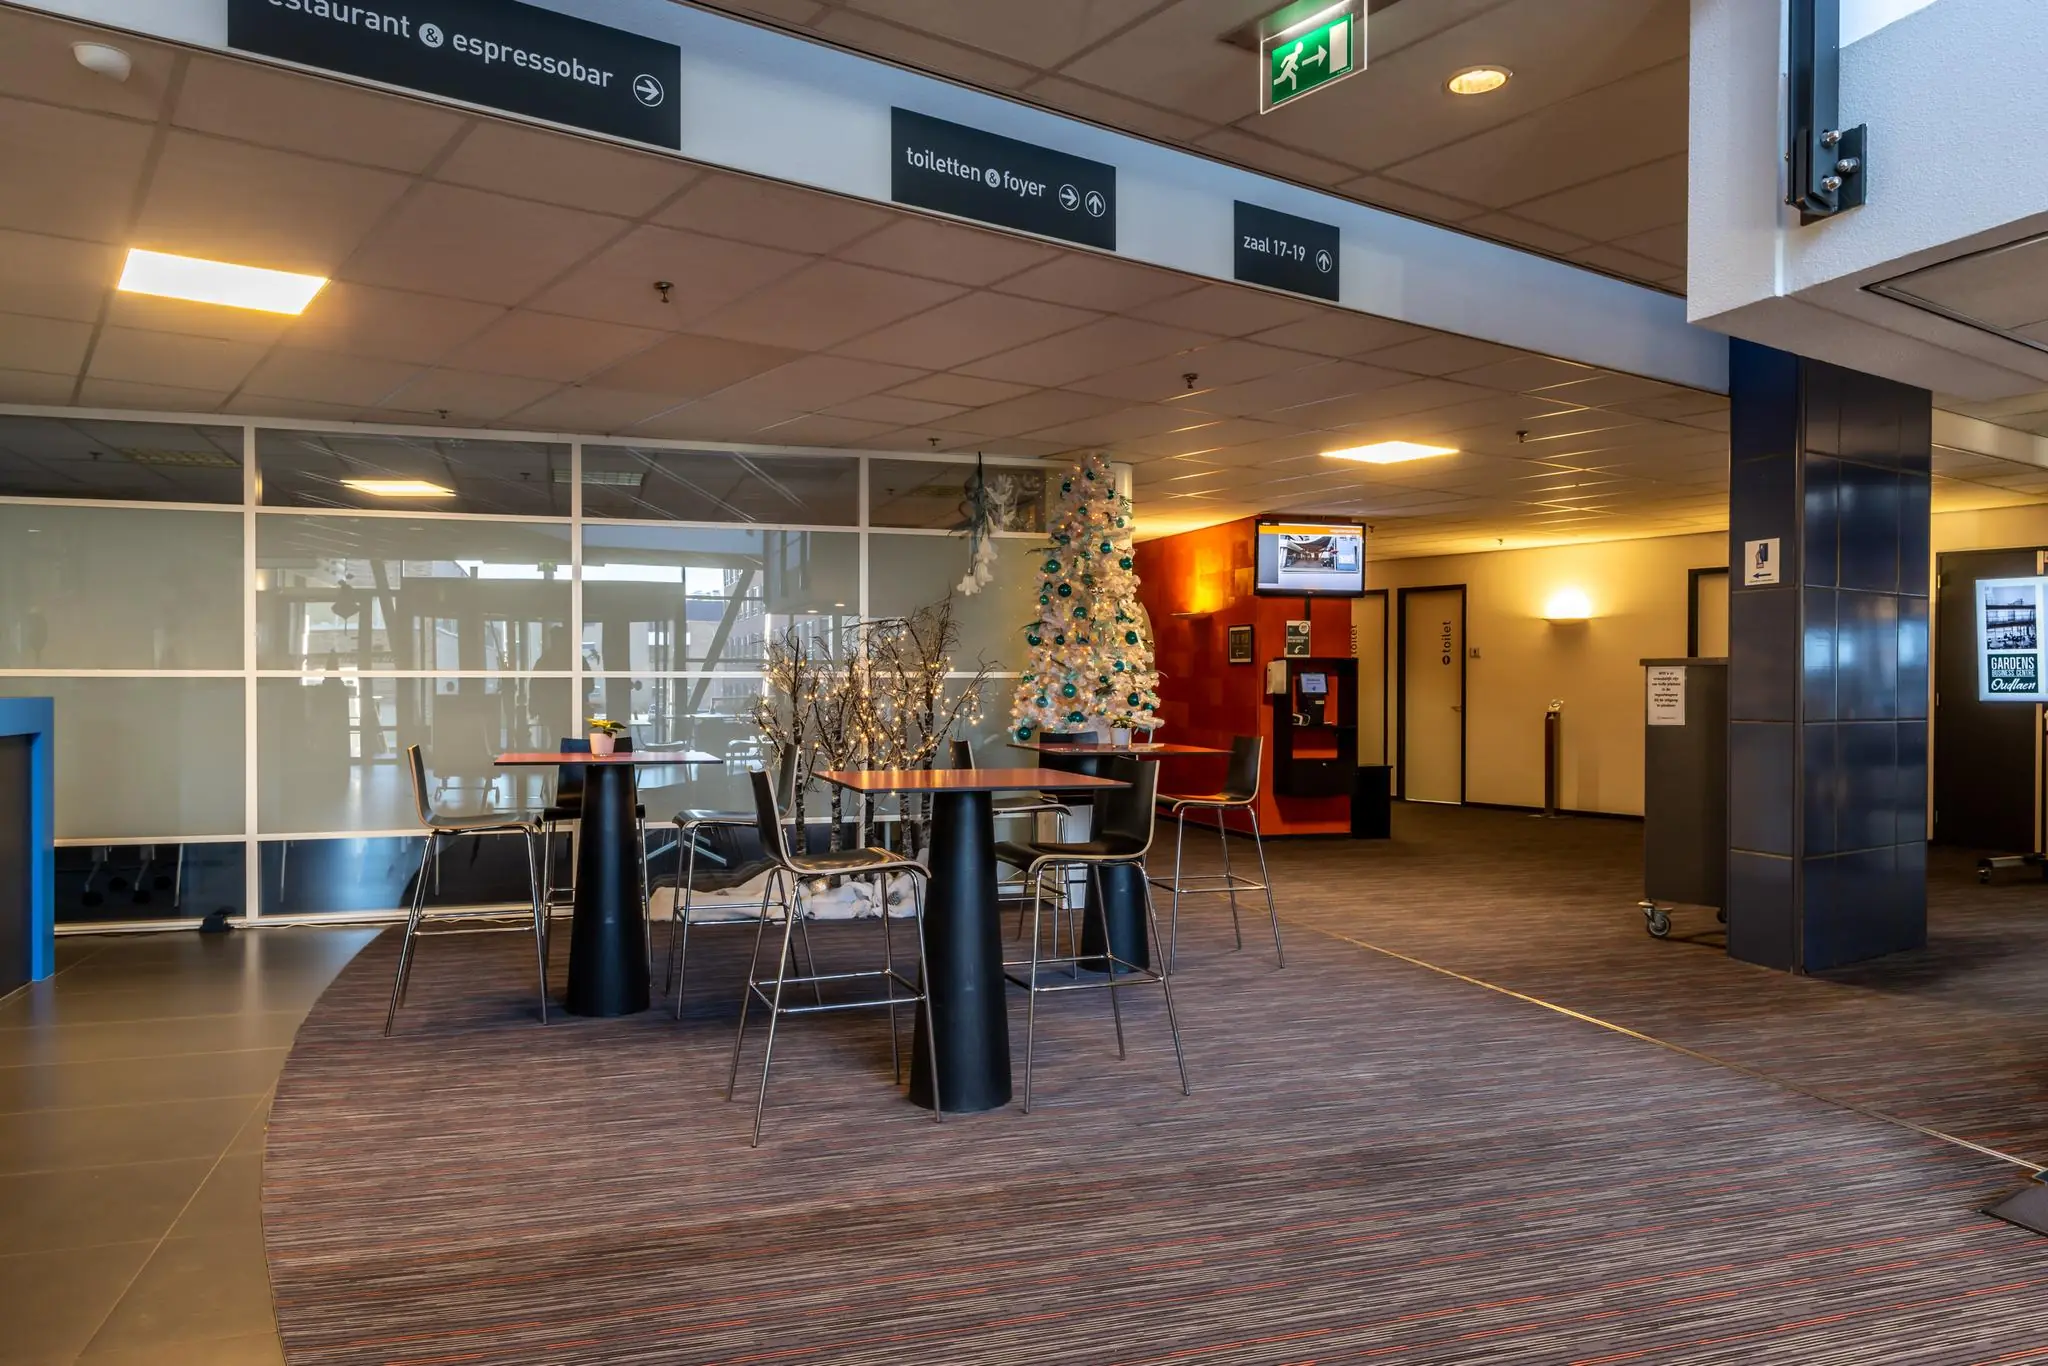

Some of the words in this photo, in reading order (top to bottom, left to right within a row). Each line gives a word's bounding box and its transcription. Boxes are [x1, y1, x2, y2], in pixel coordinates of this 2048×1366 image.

[452, 33, 614, 88] espressobar
[906, 147, 980, 182] toiletten
[1003, 171, 1046, 197] foyer
[1243, 236, 1271, 254] zaal
[1273, 239, 1306, 262] 17-19
[1441, 620, 1452, 654] toilet
[1991, 656, 2035, 670] GARDENS
